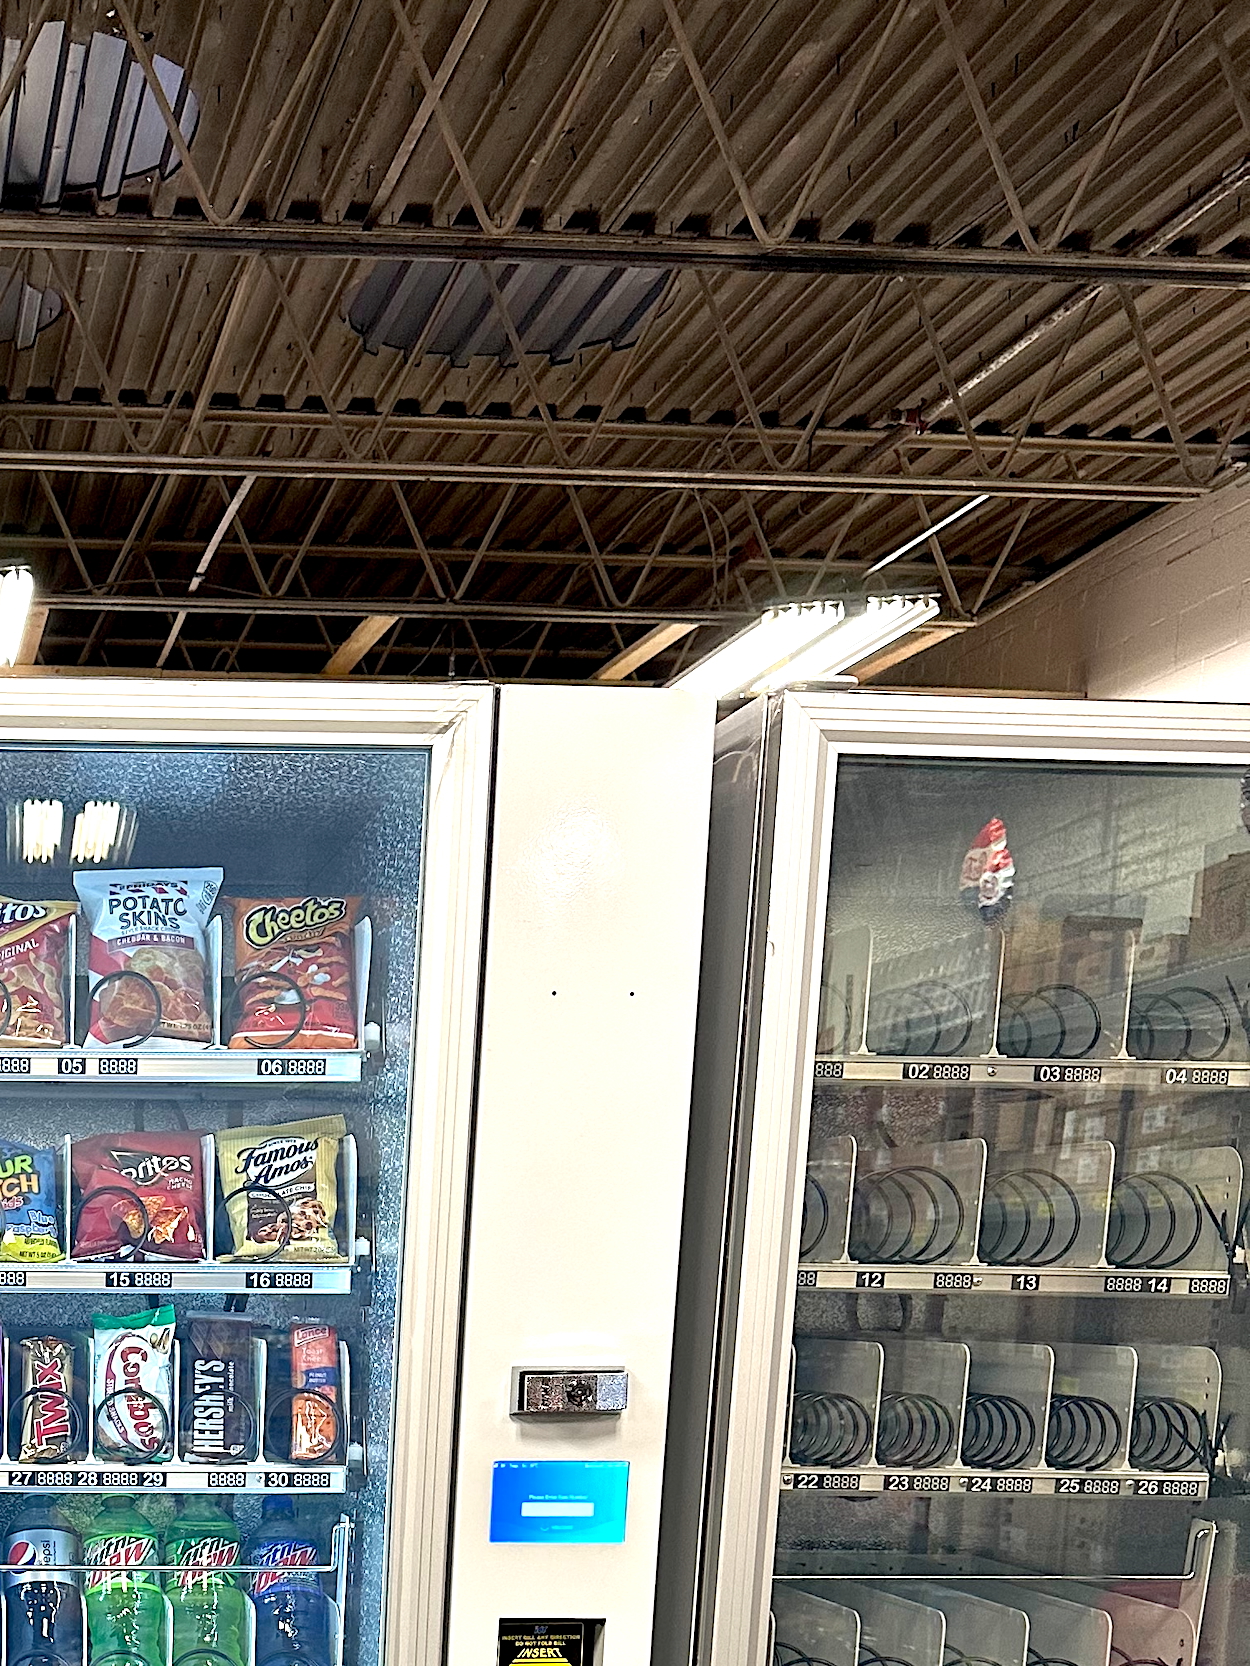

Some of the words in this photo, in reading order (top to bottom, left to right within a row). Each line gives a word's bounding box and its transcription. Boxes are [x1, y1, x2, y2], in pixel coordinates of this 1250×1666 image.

[108, 895, 188, 916] POTATO
[118, 911, 181, 930] SKINS
[244, 896, 347, 949] Cheetos
[116, 934, 150, 946] CHEDDAR
[161, 933, 186, 944] BACON
[61, 1058, 84, 1074] 05
[100, 1058, 137, 1074] 8888
[261, 1059, 282, 1075] 06
[288, 1059, 325, 1075] 8888
[908, 1064, 930, 1079] 02
[933, 1064, 969, 1080] 8888
[236, 1137, 319, 1174] Famous
[120, 1155, 192, 1182] oritos
[245, 1160, 310, 1186] Amos
[28, 1210, 55, 1224] Blue
[110, 1273, 130, 1287] 15
[135, 1273, 171, 1287] 8888
[250, 1273, 270, 1287] 16
[275, 1273, 311, 1287] 8888
[296, 1326, 328, 1342] Lance
[34, 1358, 71, 1449] TWIX
[192, 1360, 226, 1452] HERSHEY'S
[268, 1473, 289, 1486] 30
[294, 1473, 329, 1487] 8888
[798, 1475, 818, 1488] 22
[823, 1475, 858, 1489] 8888
[1138, 1481, 1158, 1494] 26
[1162, 1480, 1197, 1495] 8888
[517, 1647, 563, 1658] INSERT
